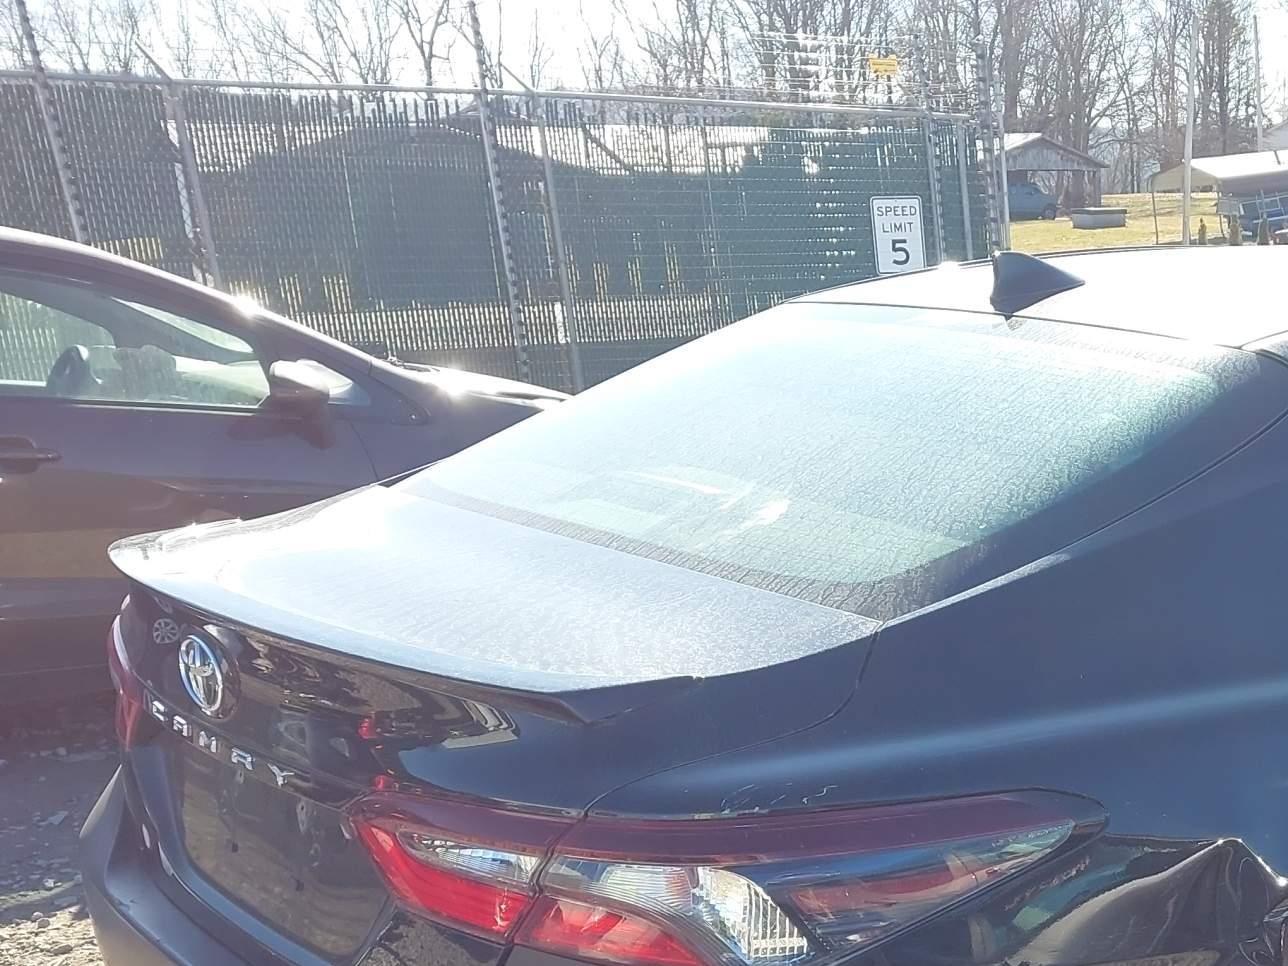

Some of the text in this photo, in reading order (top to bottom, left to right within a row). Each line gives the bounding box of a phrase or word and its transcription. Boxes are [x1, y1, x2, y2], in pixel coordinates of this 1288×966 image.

[876, 205, 917, 216] SPEED
[881, 222, 914, 233] LIMIT
[891, 238, 910, 266] 5
[151, 700, 296, 788] CAMRY
